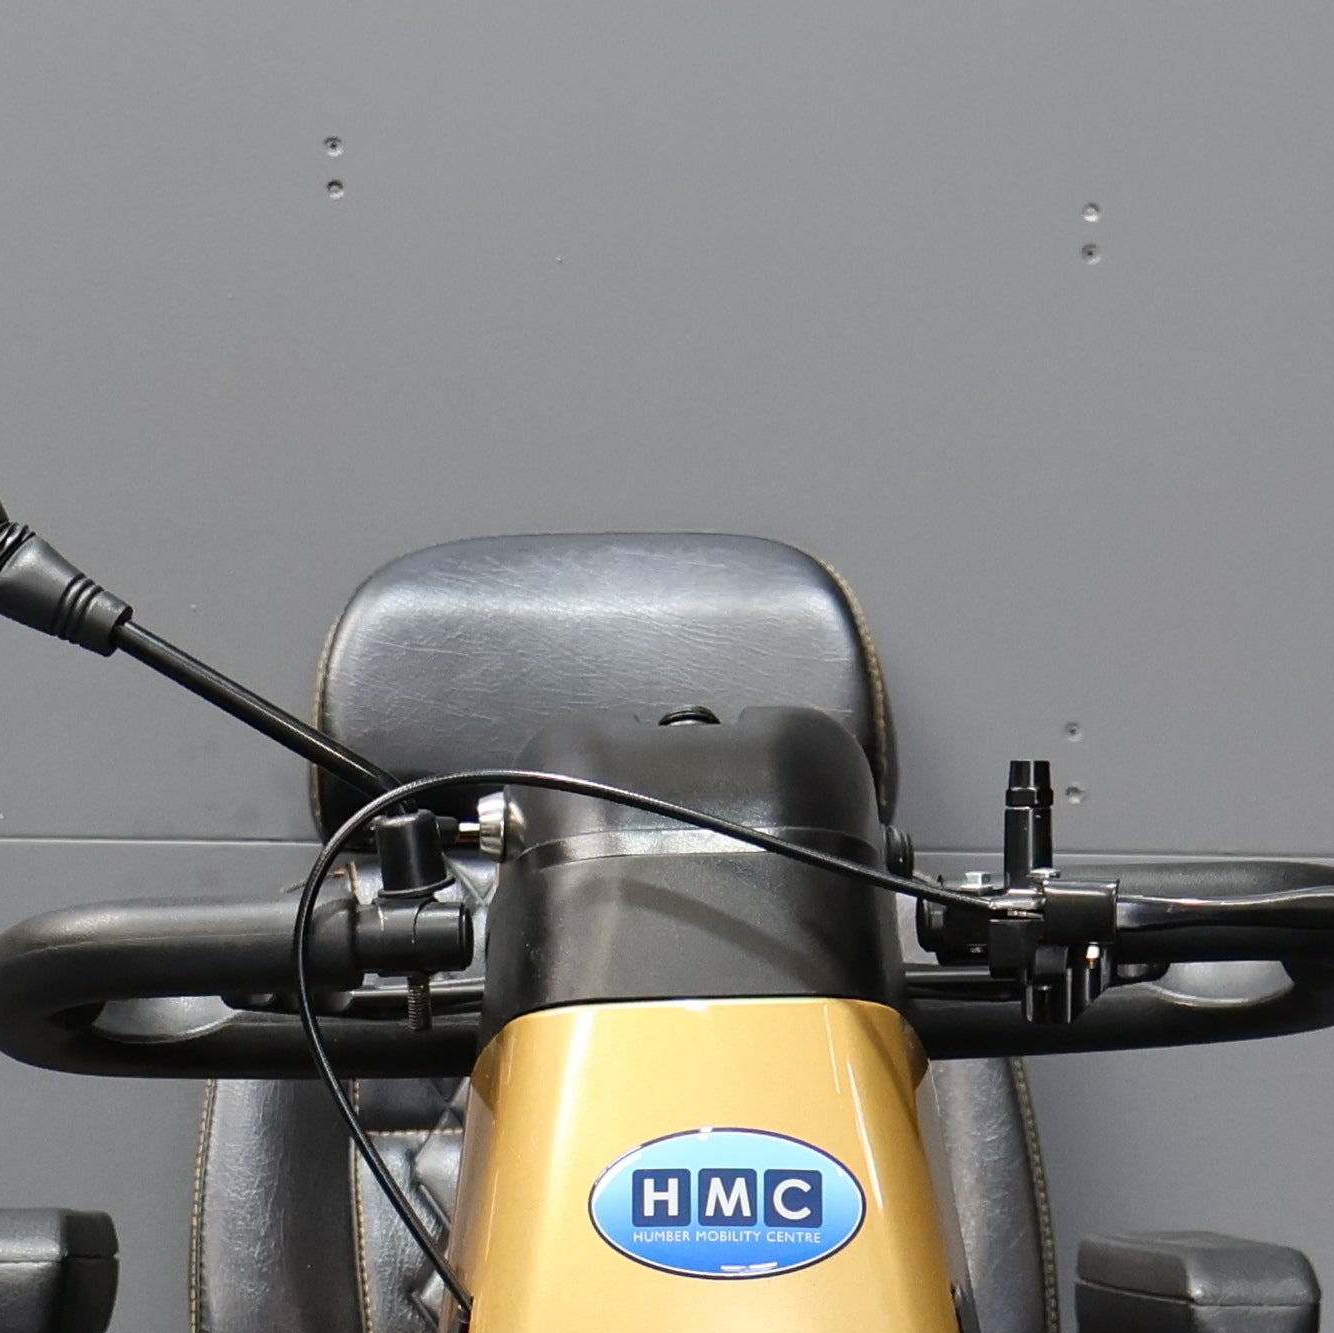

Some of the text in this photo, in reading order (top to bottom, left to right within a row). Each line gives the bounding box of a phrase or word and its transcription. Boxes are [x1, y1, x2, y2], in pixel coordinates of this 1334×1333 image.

[642, 1177, 812, 1220] HMC
[632, 1230, 822, 1244] HUMBER MOBILITY CENTRE
